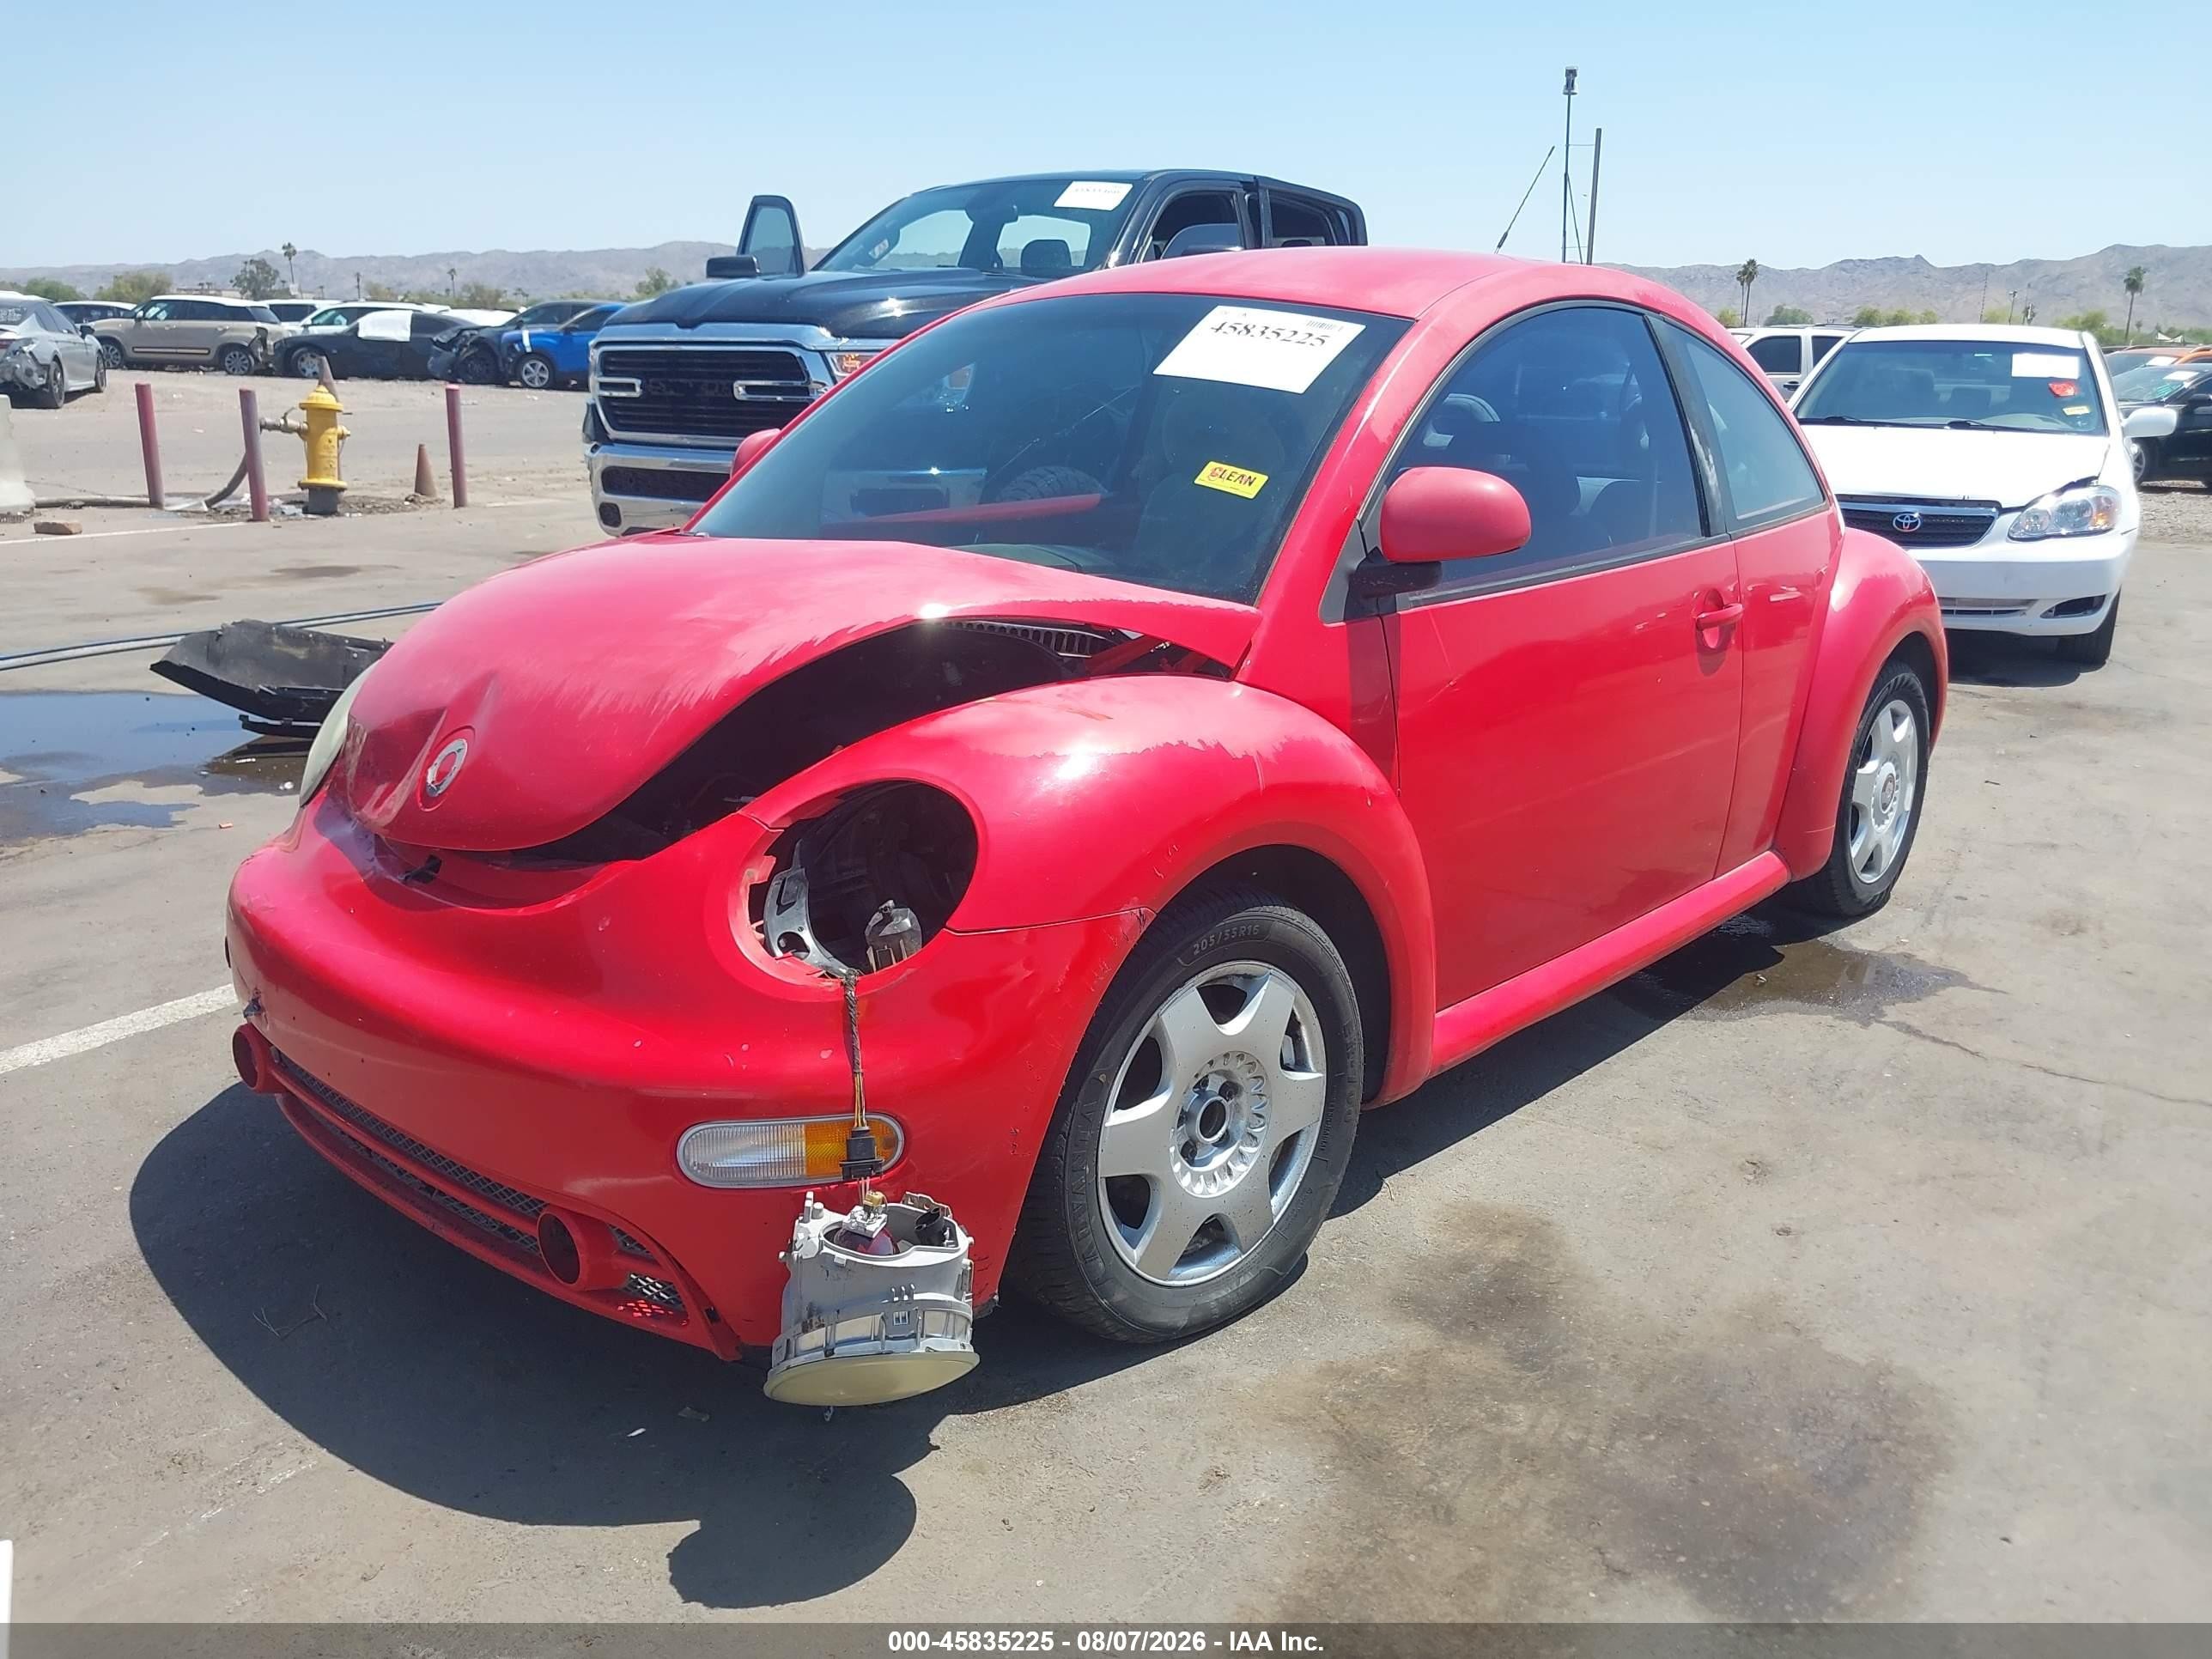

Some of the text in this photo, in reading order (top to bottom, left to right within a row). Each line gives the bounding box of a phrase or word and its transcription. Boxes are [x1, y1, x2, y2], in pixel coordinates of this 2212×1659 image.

[1211, 321, 1330, 347] 45835225
[1208, 466, 1256, 487] CLEAN
[1193, 924, 1260, 956] 205/55R16
